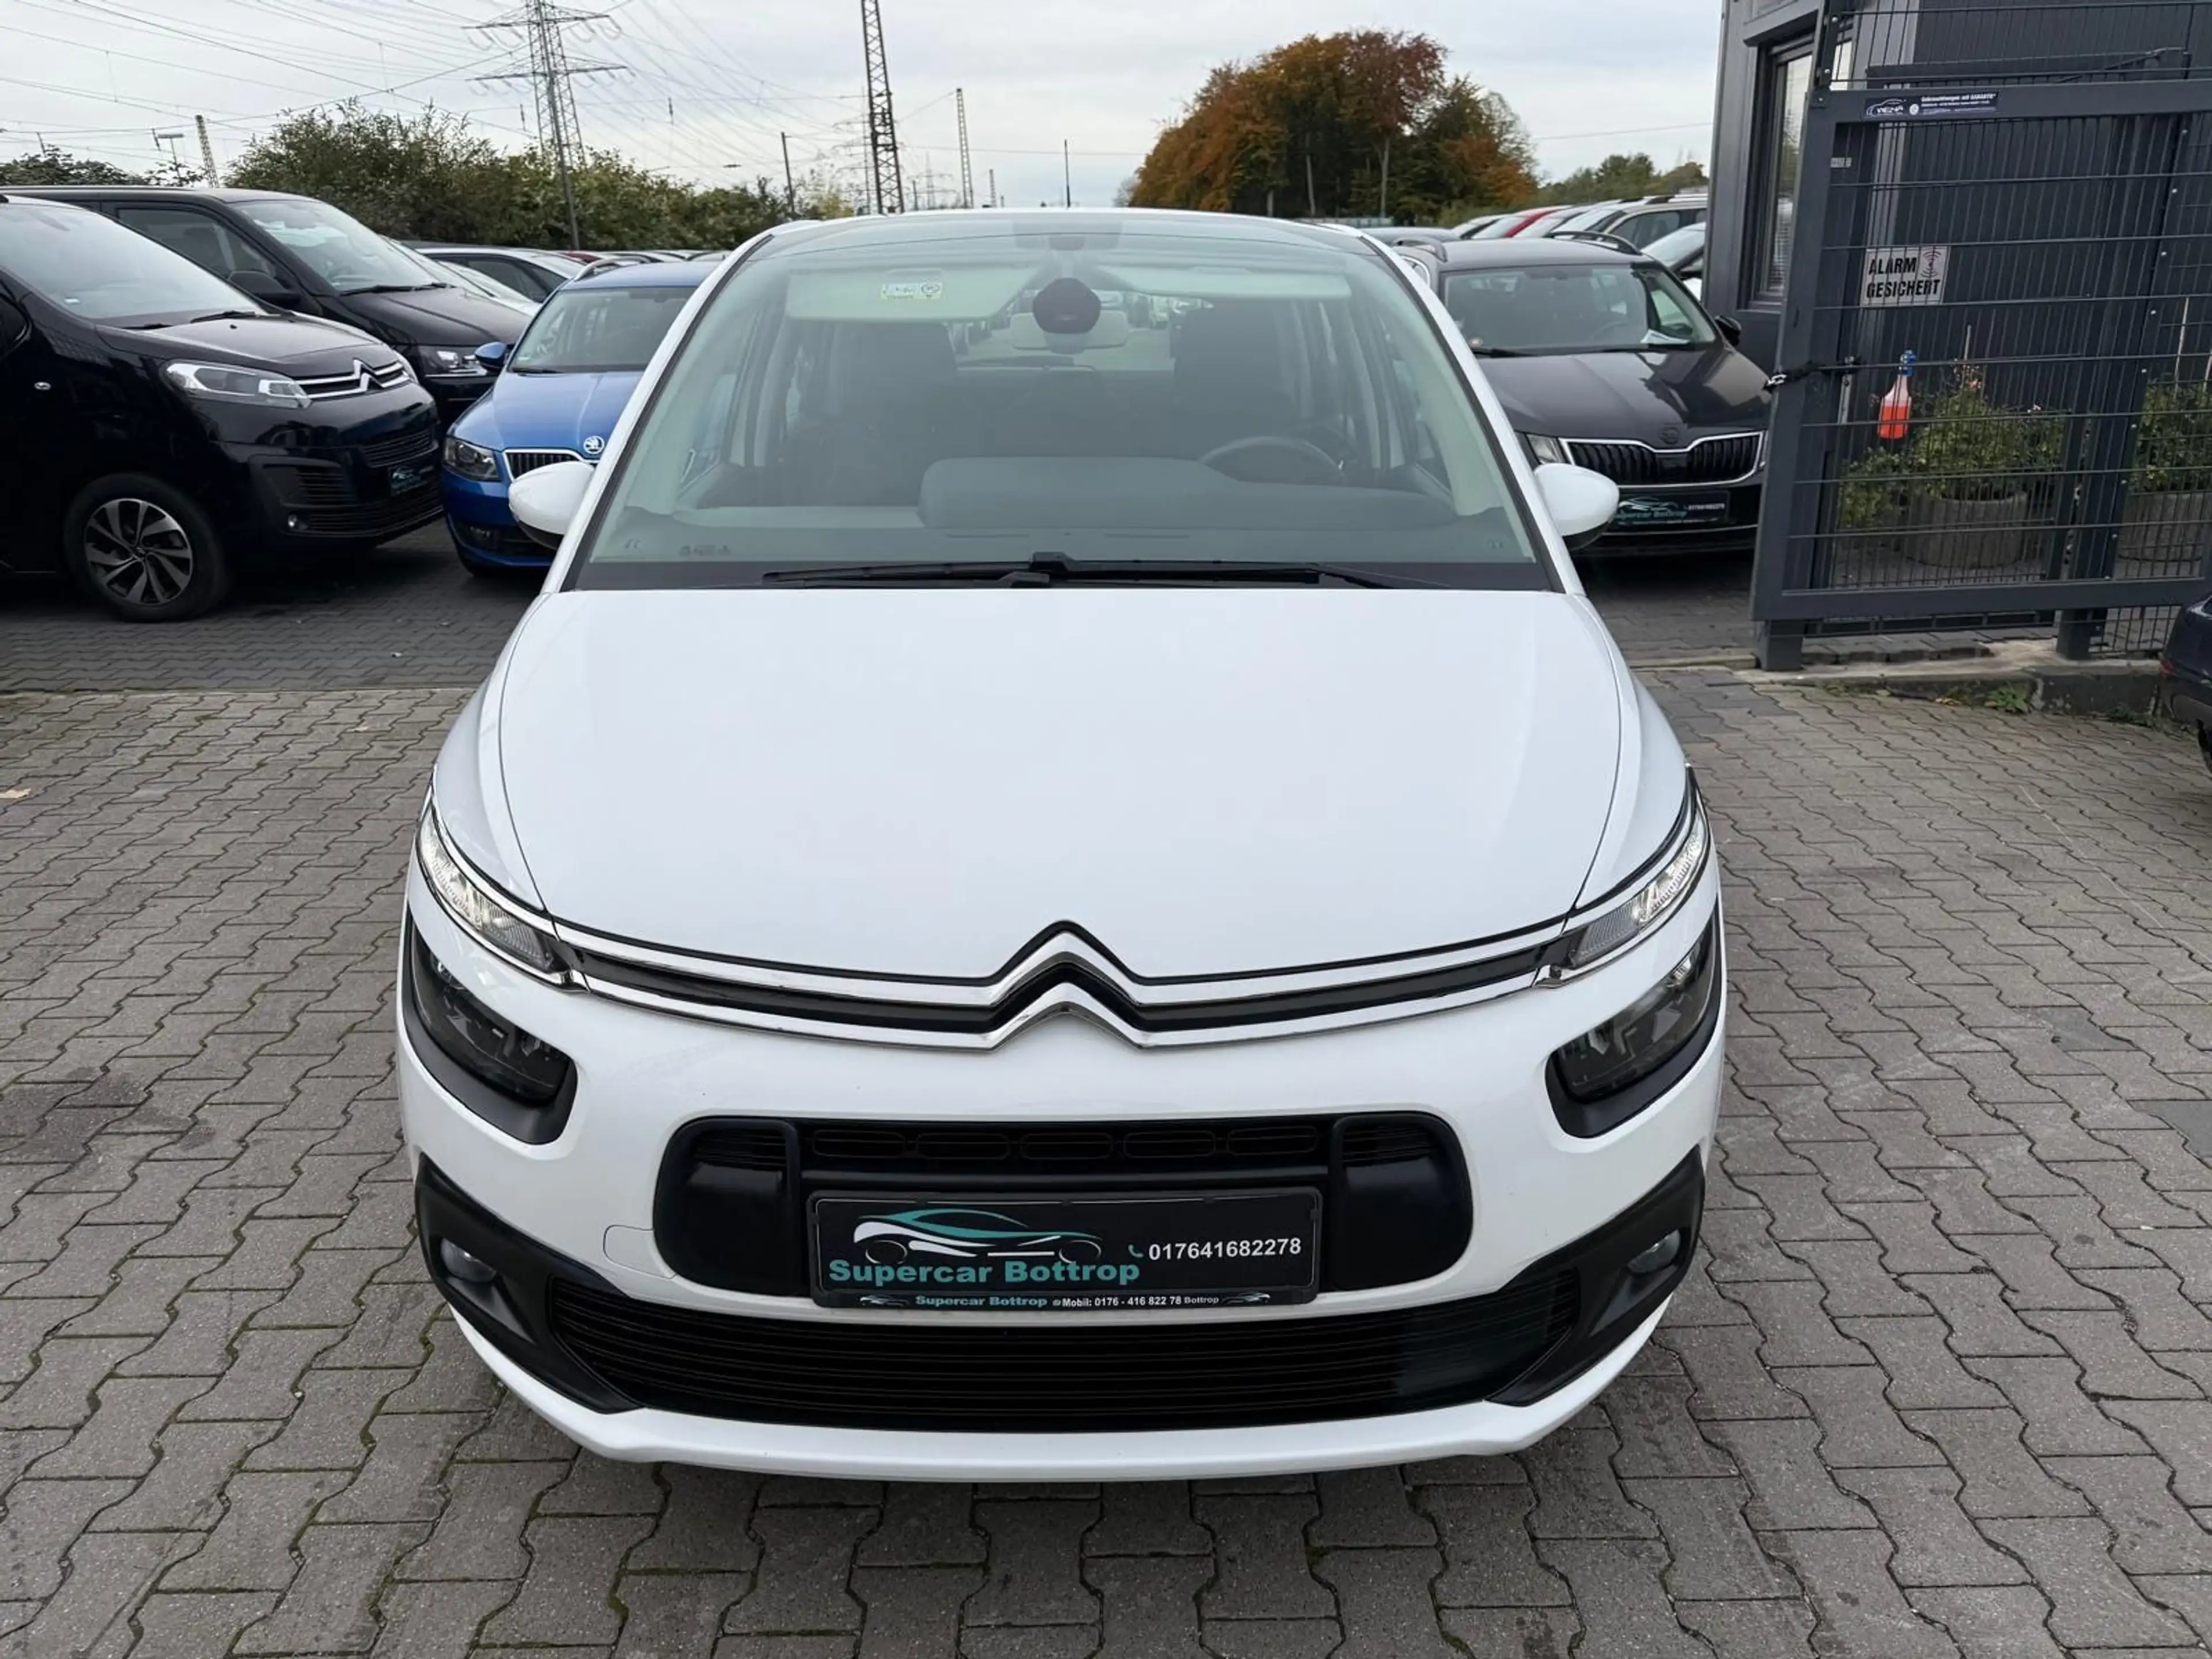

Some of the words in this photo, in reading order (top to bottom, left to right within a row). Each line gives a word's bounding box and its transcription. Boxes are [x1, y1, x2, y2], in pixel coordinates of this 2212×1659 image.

[1869, 257, 1917, 275] ALARM
[1866, 279, 1941, 298] GESICHERT
[1149, 1238, 1301, 1260] 017641682278
[829, 1259, 992, 1286] Supercar
[1005, 1260, 1140, 1285] Bottrop
[915, 1295, 986, 1307] Supercar
[990, 1296, 1048, 1307] Bottrop
[1094, 1296, 1119, 1306] 0176
[1127, 1296, 1146, 1306] 416
[1149, 1296, 1167, 1305] 822
[1170, 1295, 1181, 1305] 78
[1184, 1296, 1219, 1304] Bottrop
